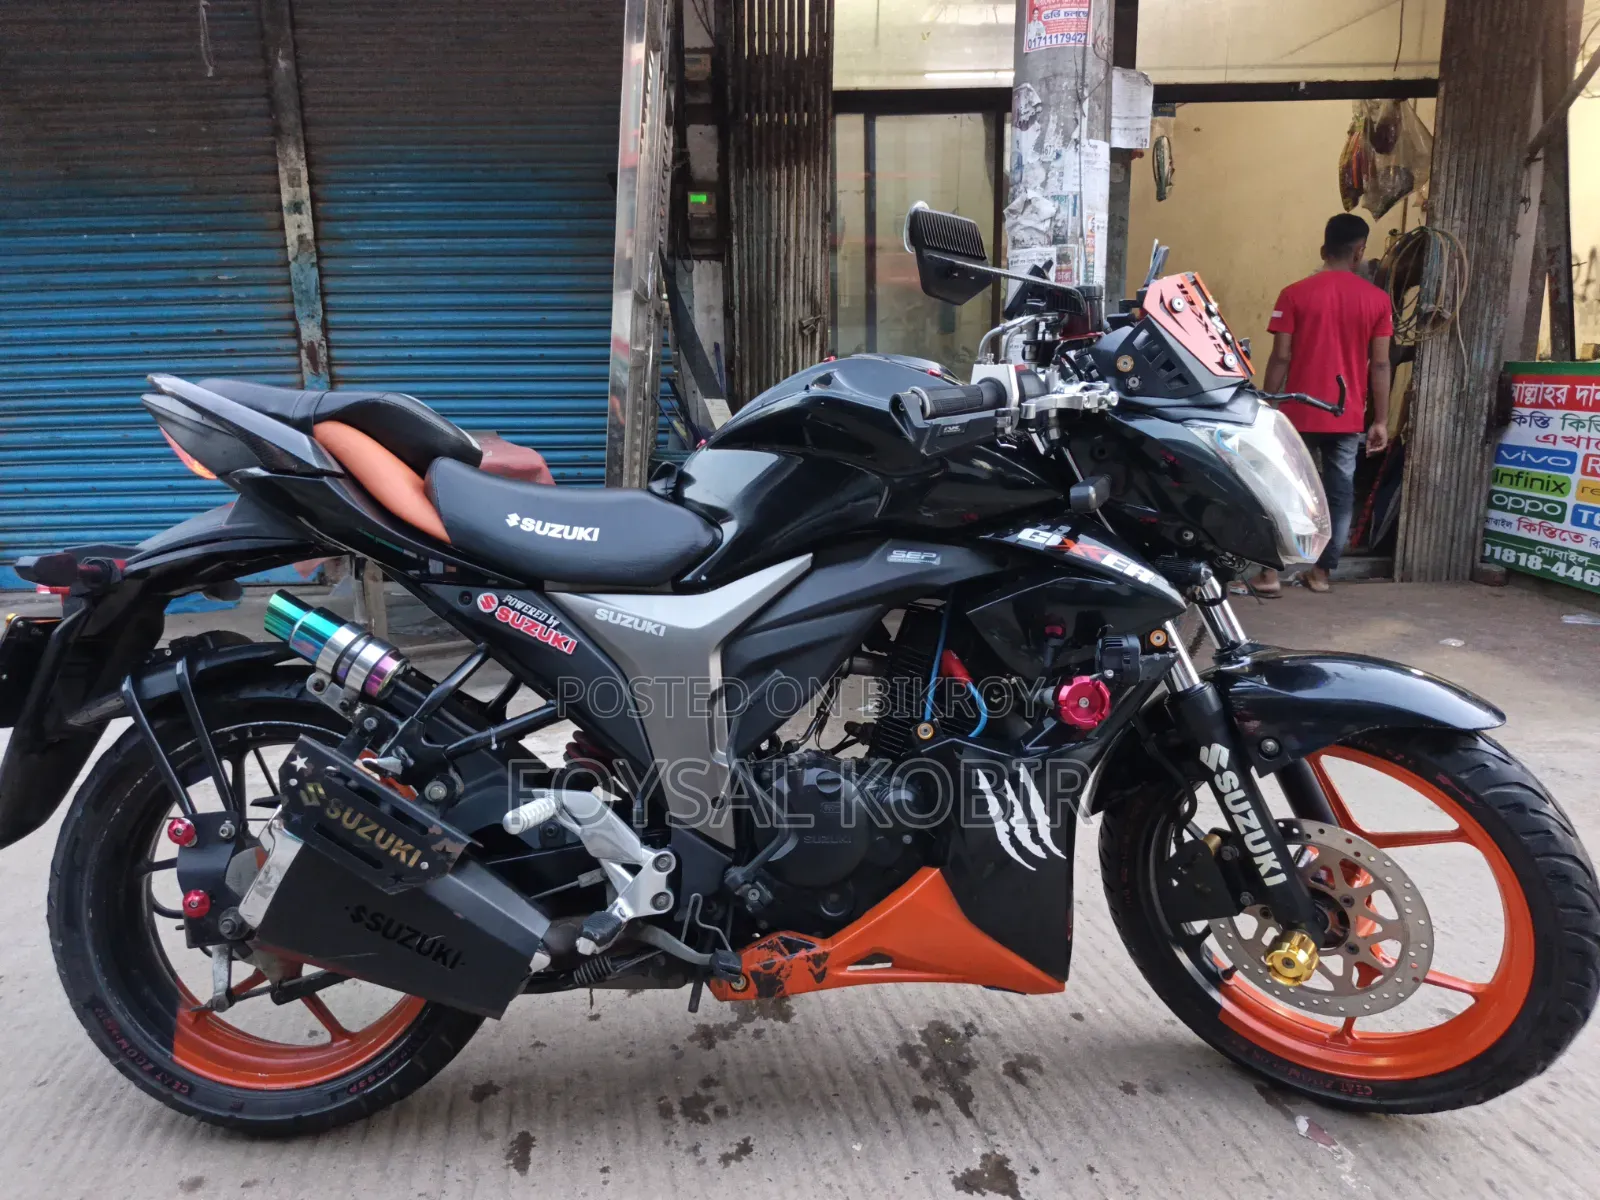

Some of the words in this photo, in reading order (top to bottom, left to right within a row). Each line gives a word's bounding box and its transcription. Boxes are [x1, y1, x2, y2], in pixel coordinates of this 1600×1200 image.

[1501, 450, 1571, 467] vivo
[1494, 469, 1567, 495] Infinix
[520, 517, 600, 542] SUZUKI
[890, 549, 937, 560] SEP
[1017, 527, 1155, 584] GIXXER
[502, 594, 549, 622] POWERED
[547, 612, 560, 629] by
[594, 607, 667, 637] SUZUKI
[494, 604, 578, 655] SUZUKI
[326, 800, 422, 869] SUZUKI
[1214, 770, 1288, 887] SUZUKI
[367, 912, 464, 971] SUZUKI
